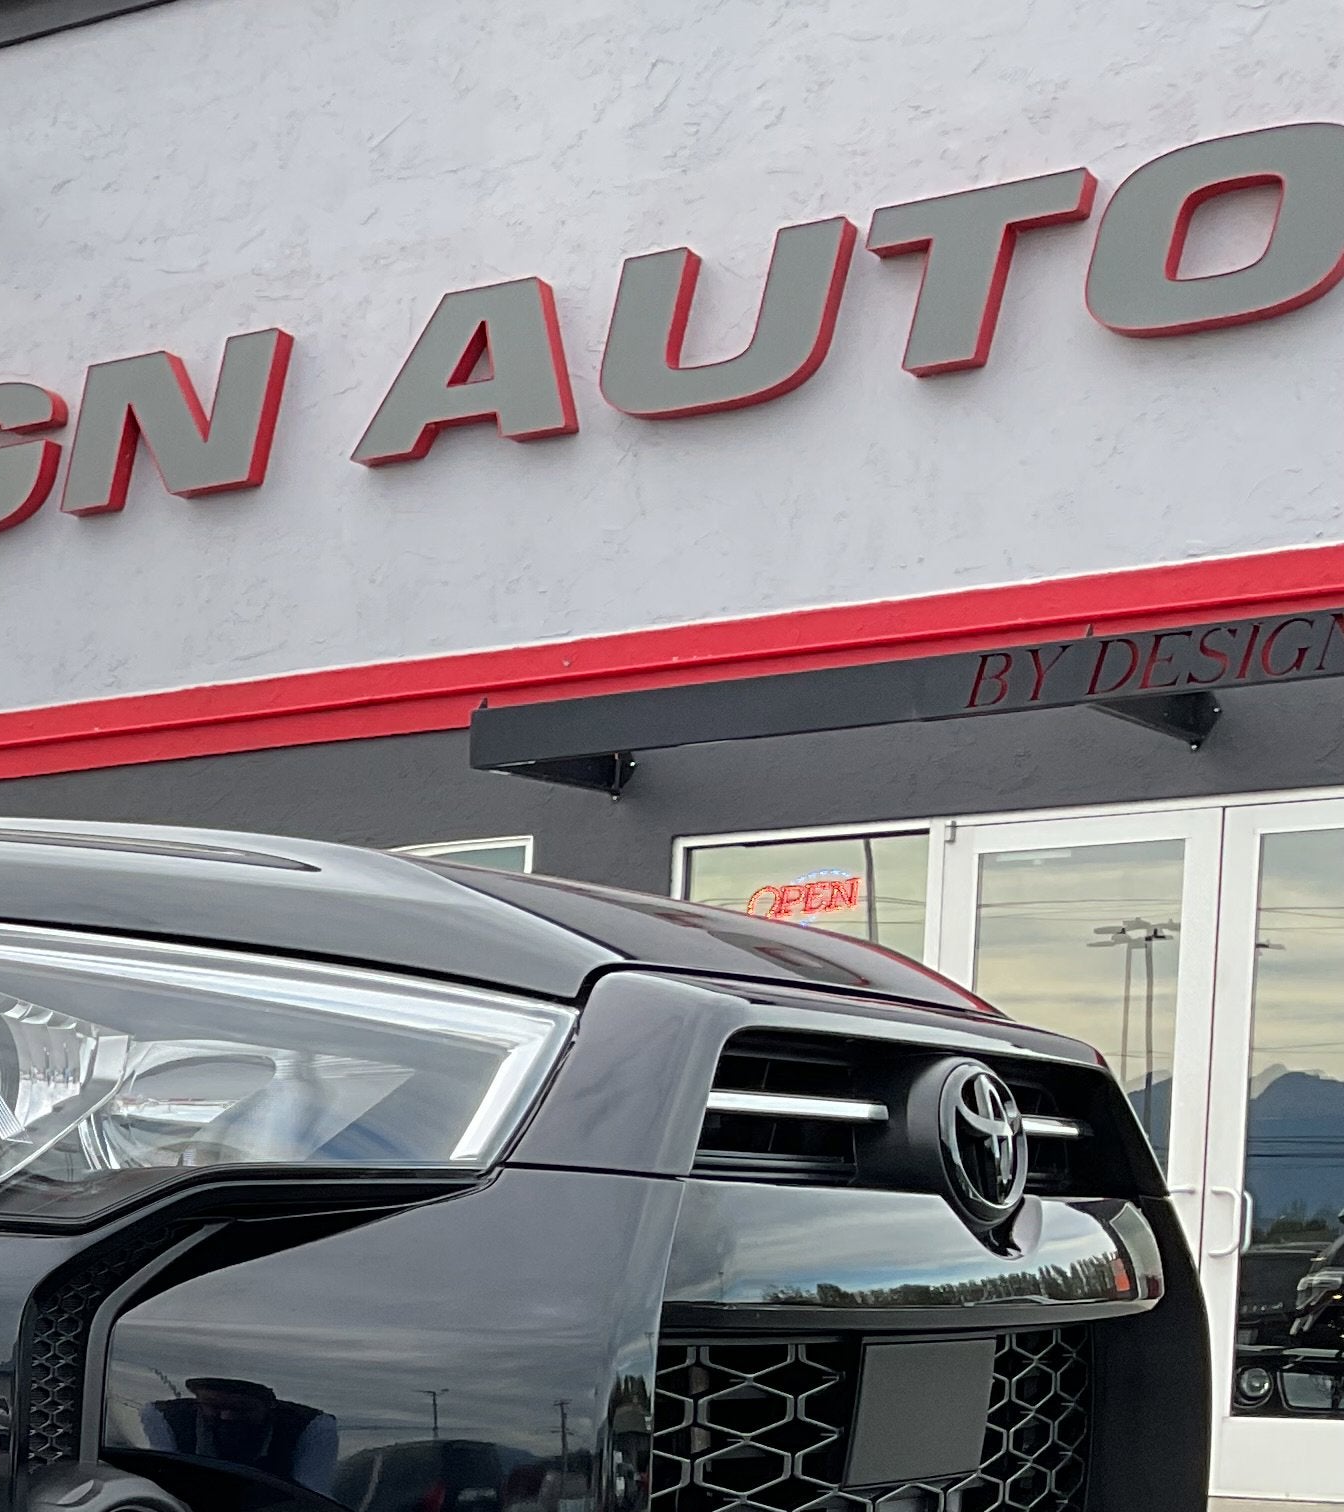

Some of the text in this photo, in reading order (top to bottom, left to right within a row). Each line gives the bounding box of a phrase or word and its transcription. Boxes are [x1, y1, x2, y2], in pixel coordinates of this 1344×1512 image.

[351, 122, 1344, 468] AUTO
[964, 643, 1073, 709] BY
[745, 877, 862, 920] OPEN
